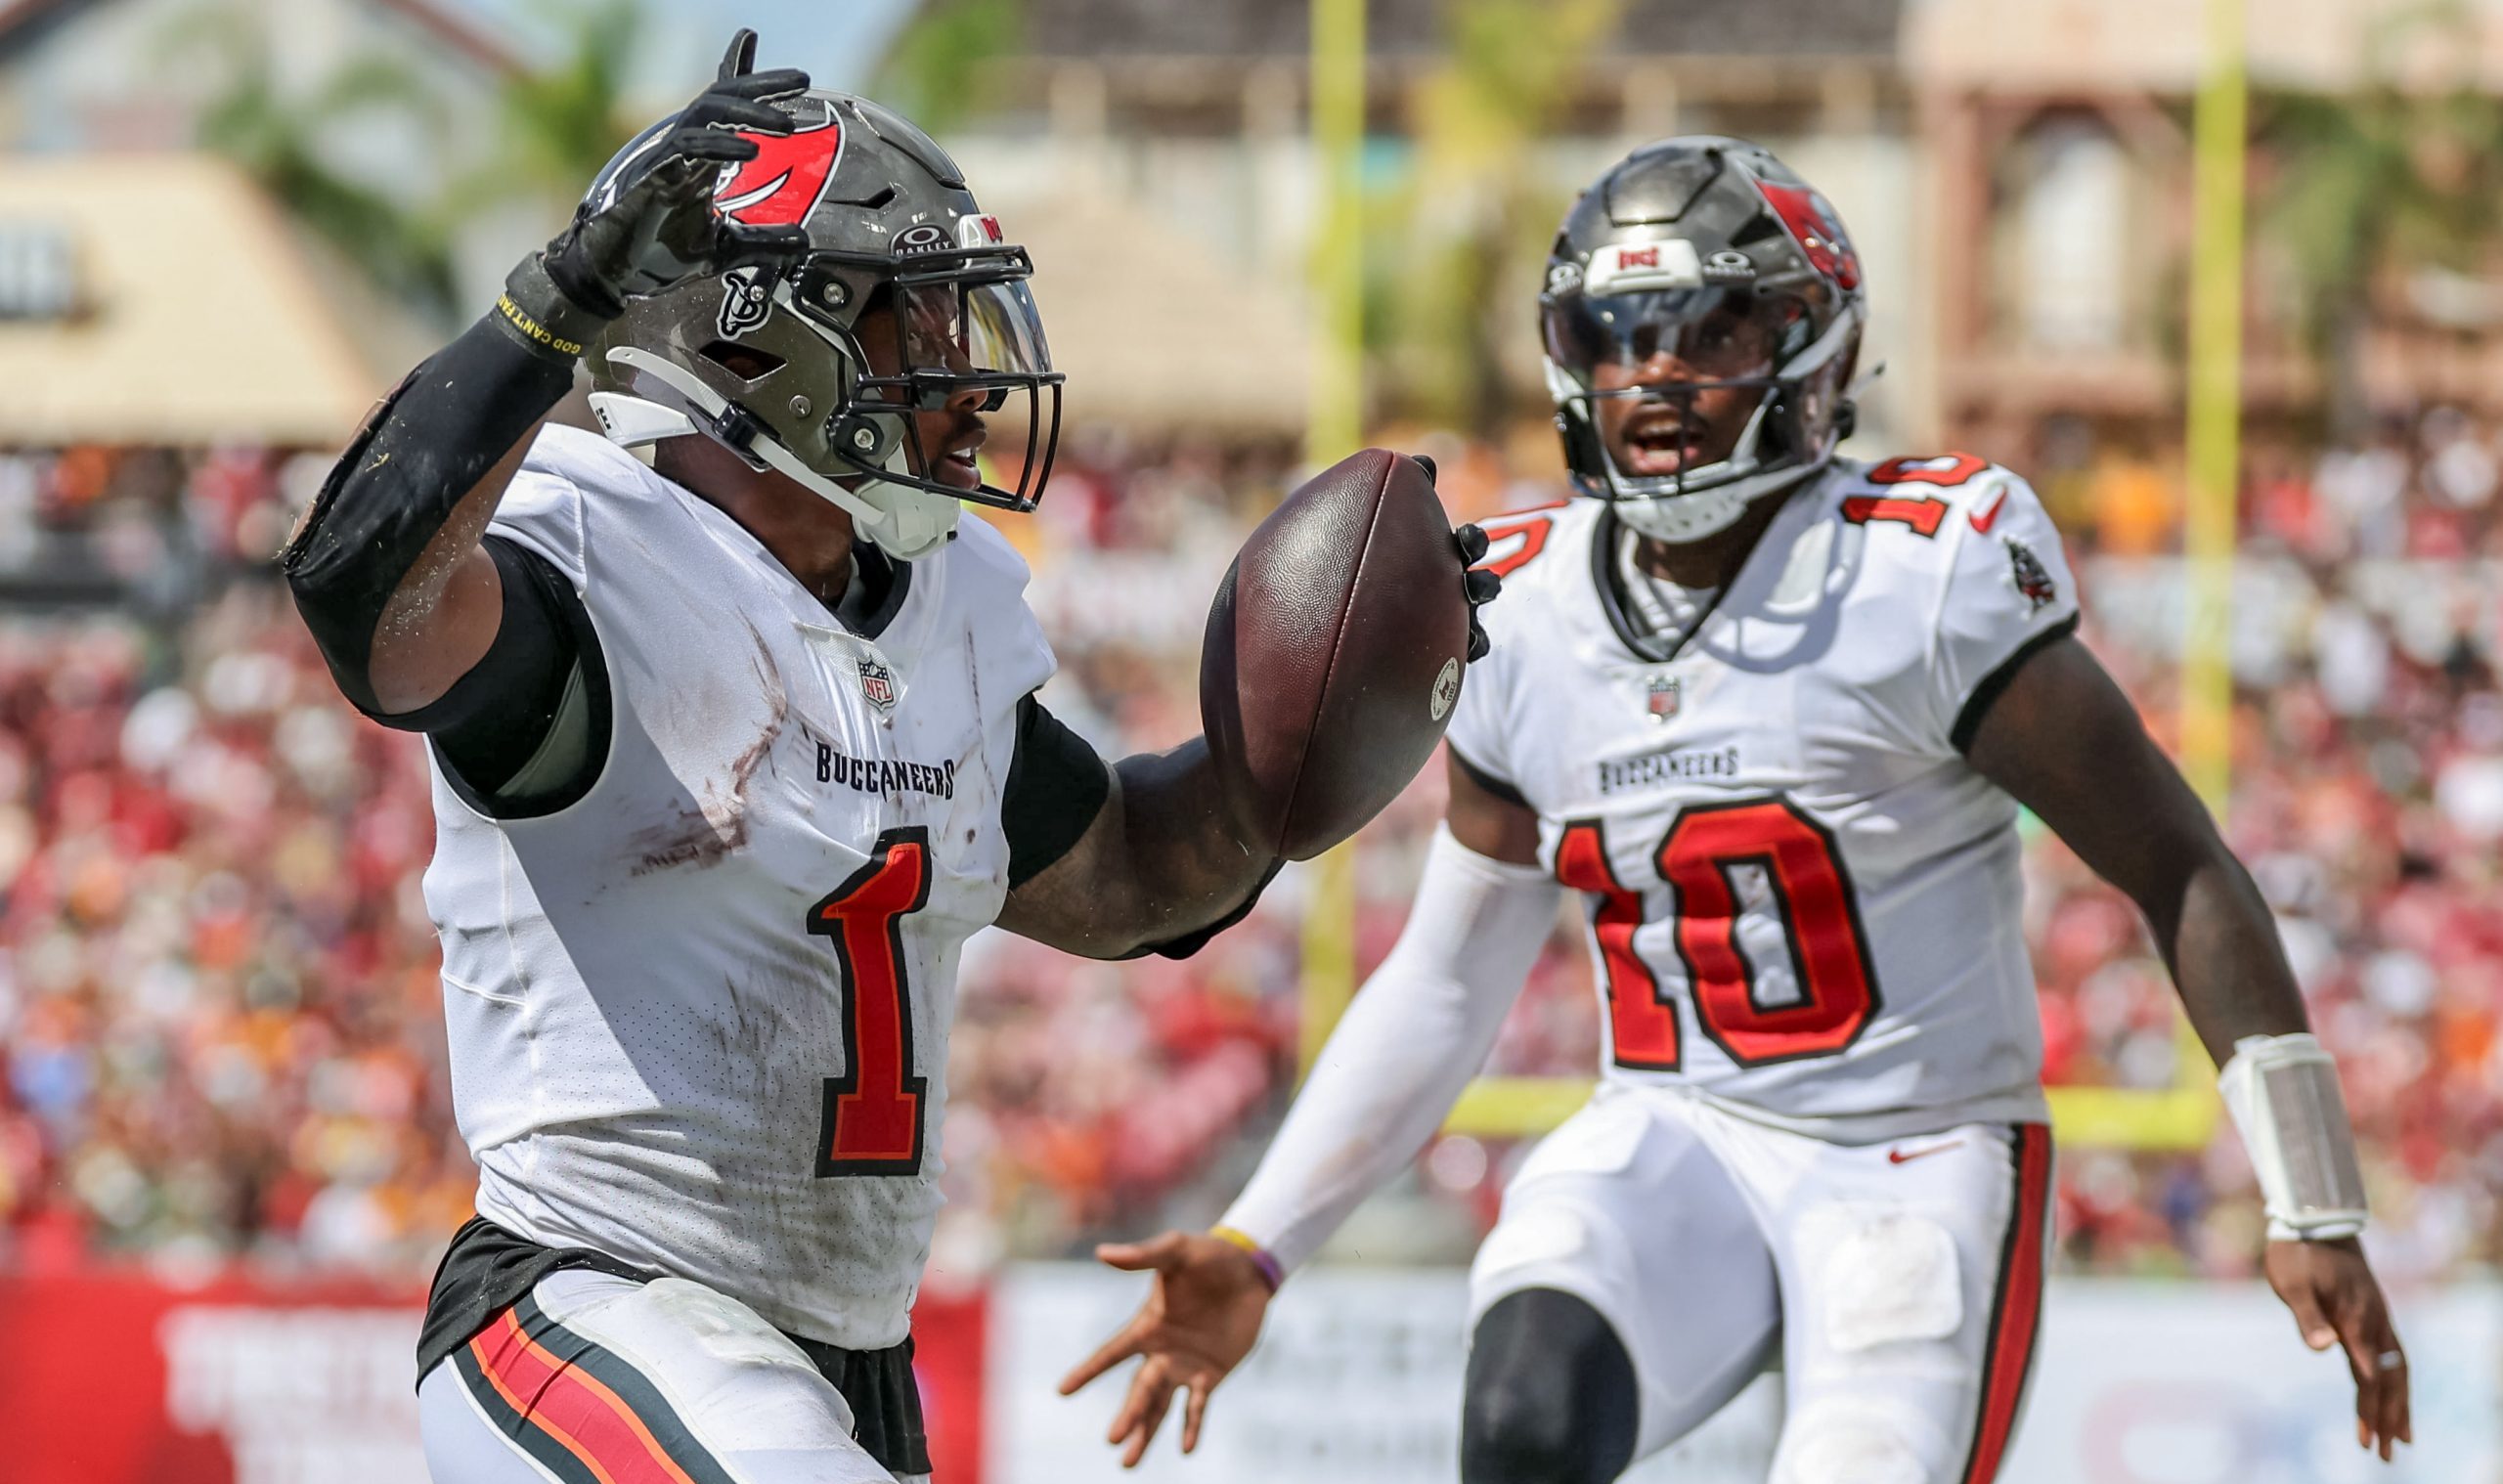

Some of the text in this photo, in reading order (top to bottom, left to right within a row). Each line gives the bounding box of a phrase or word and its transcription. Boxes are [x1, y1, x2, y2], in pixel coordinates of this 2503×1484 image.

[511, 312, 551, 344] CAN'T
[552, 338, 582, 355] GOD
[1837, 451, 1990, 540] 10
[863, 677, 892, 700] NFL
[814, 739, 955, 801] BUCCANEERS
[1555, 791, 1884, 1072] 10
[807, 825, 932, 1177] 1
